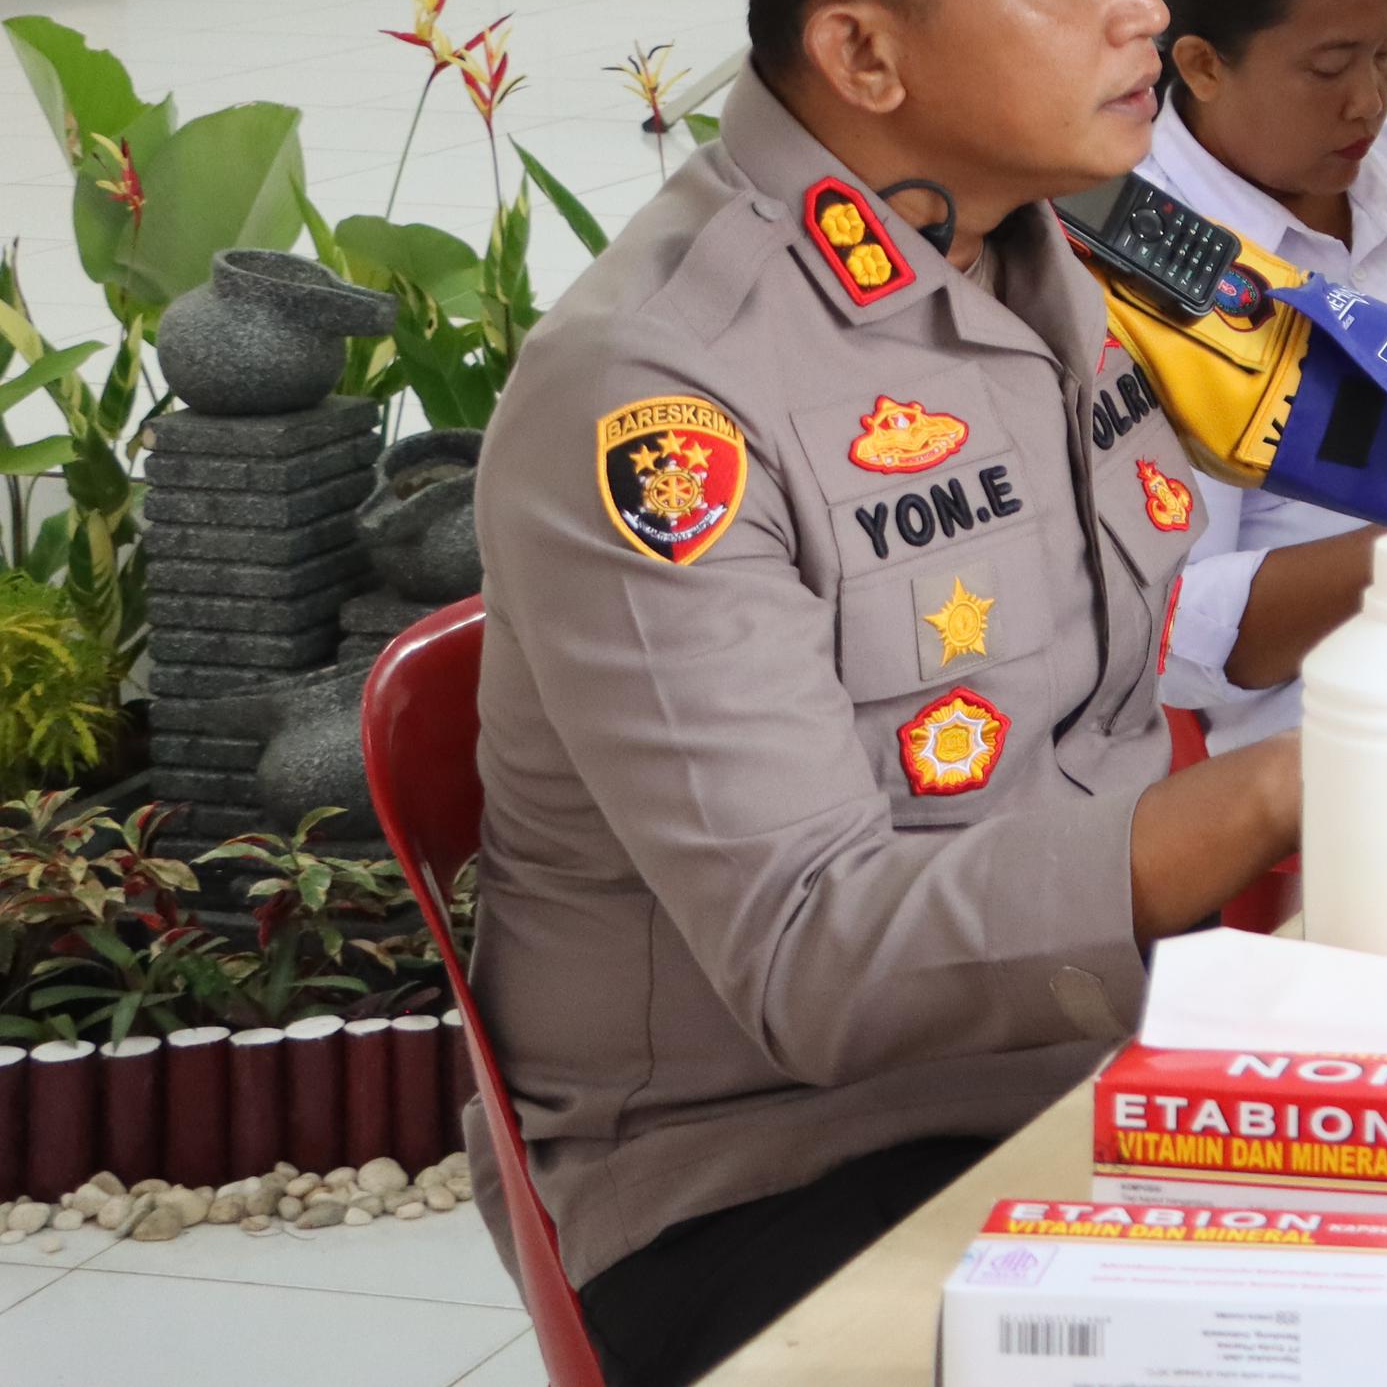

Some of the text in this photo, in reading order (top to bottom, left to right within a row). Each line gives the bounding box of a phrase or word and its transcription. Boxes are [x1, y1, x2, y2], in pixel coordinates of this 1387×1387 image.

[607, 404, 736, 439] BARESKRIM
[1093, 362, 1161, 451] OLRI
[855, 465, 1023, 560] YON.E
[1117, 1131, 1224, 1166] VITAMIN
[1231, 1137, 1283, 1171] DAN
[1007, 1220, 1316, 1245] VITAMIN DAN MINERAL
[1009, 1202, 1323, 1232] ETABION
